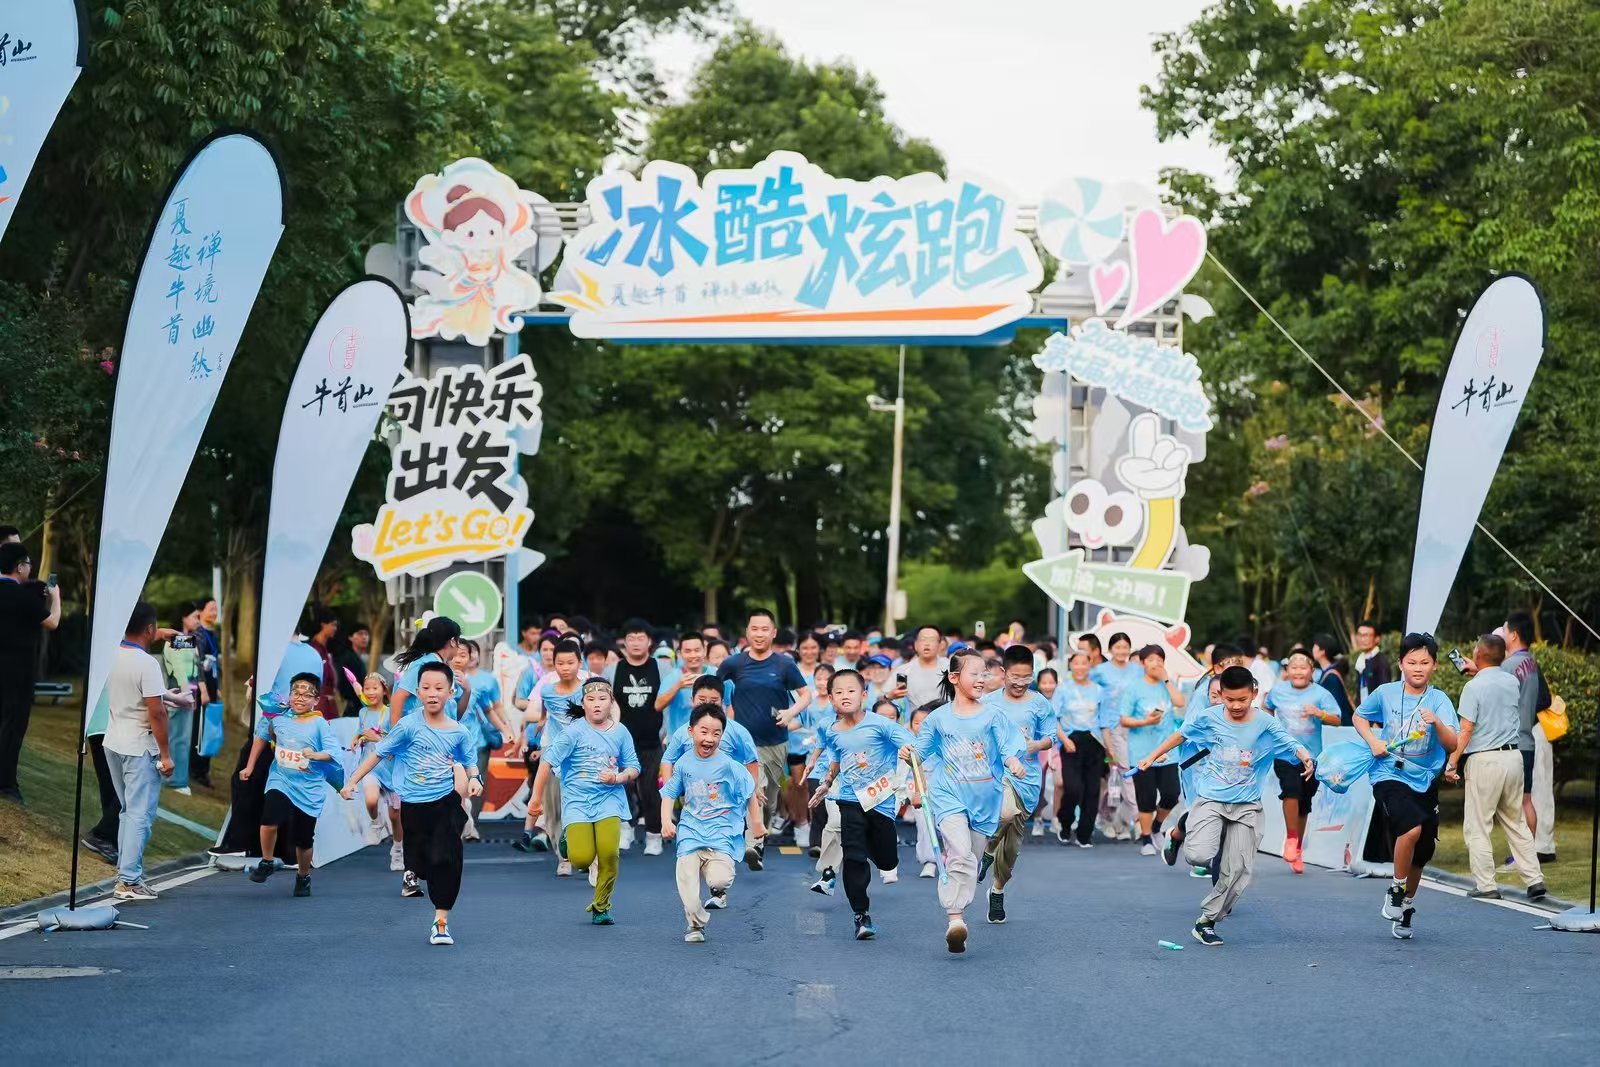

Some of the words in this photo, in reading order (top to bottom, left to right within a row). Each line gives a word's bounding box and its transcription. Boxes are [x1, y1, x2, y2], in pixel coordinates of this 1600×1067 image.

[581, 166, 1028, 309] 冰酷炫跑
[162, 197, 193, 345] 夏趣牛首
[302, 376, 374, 417] 牛首山
[1451, 375, 1514, 416] 牛首山
[394, 431, 514, 513] 出发
[373, 510, 458, 556] Let's
[462, 509, 527, 547] Go!
[280, 750, 301, 763] 045
